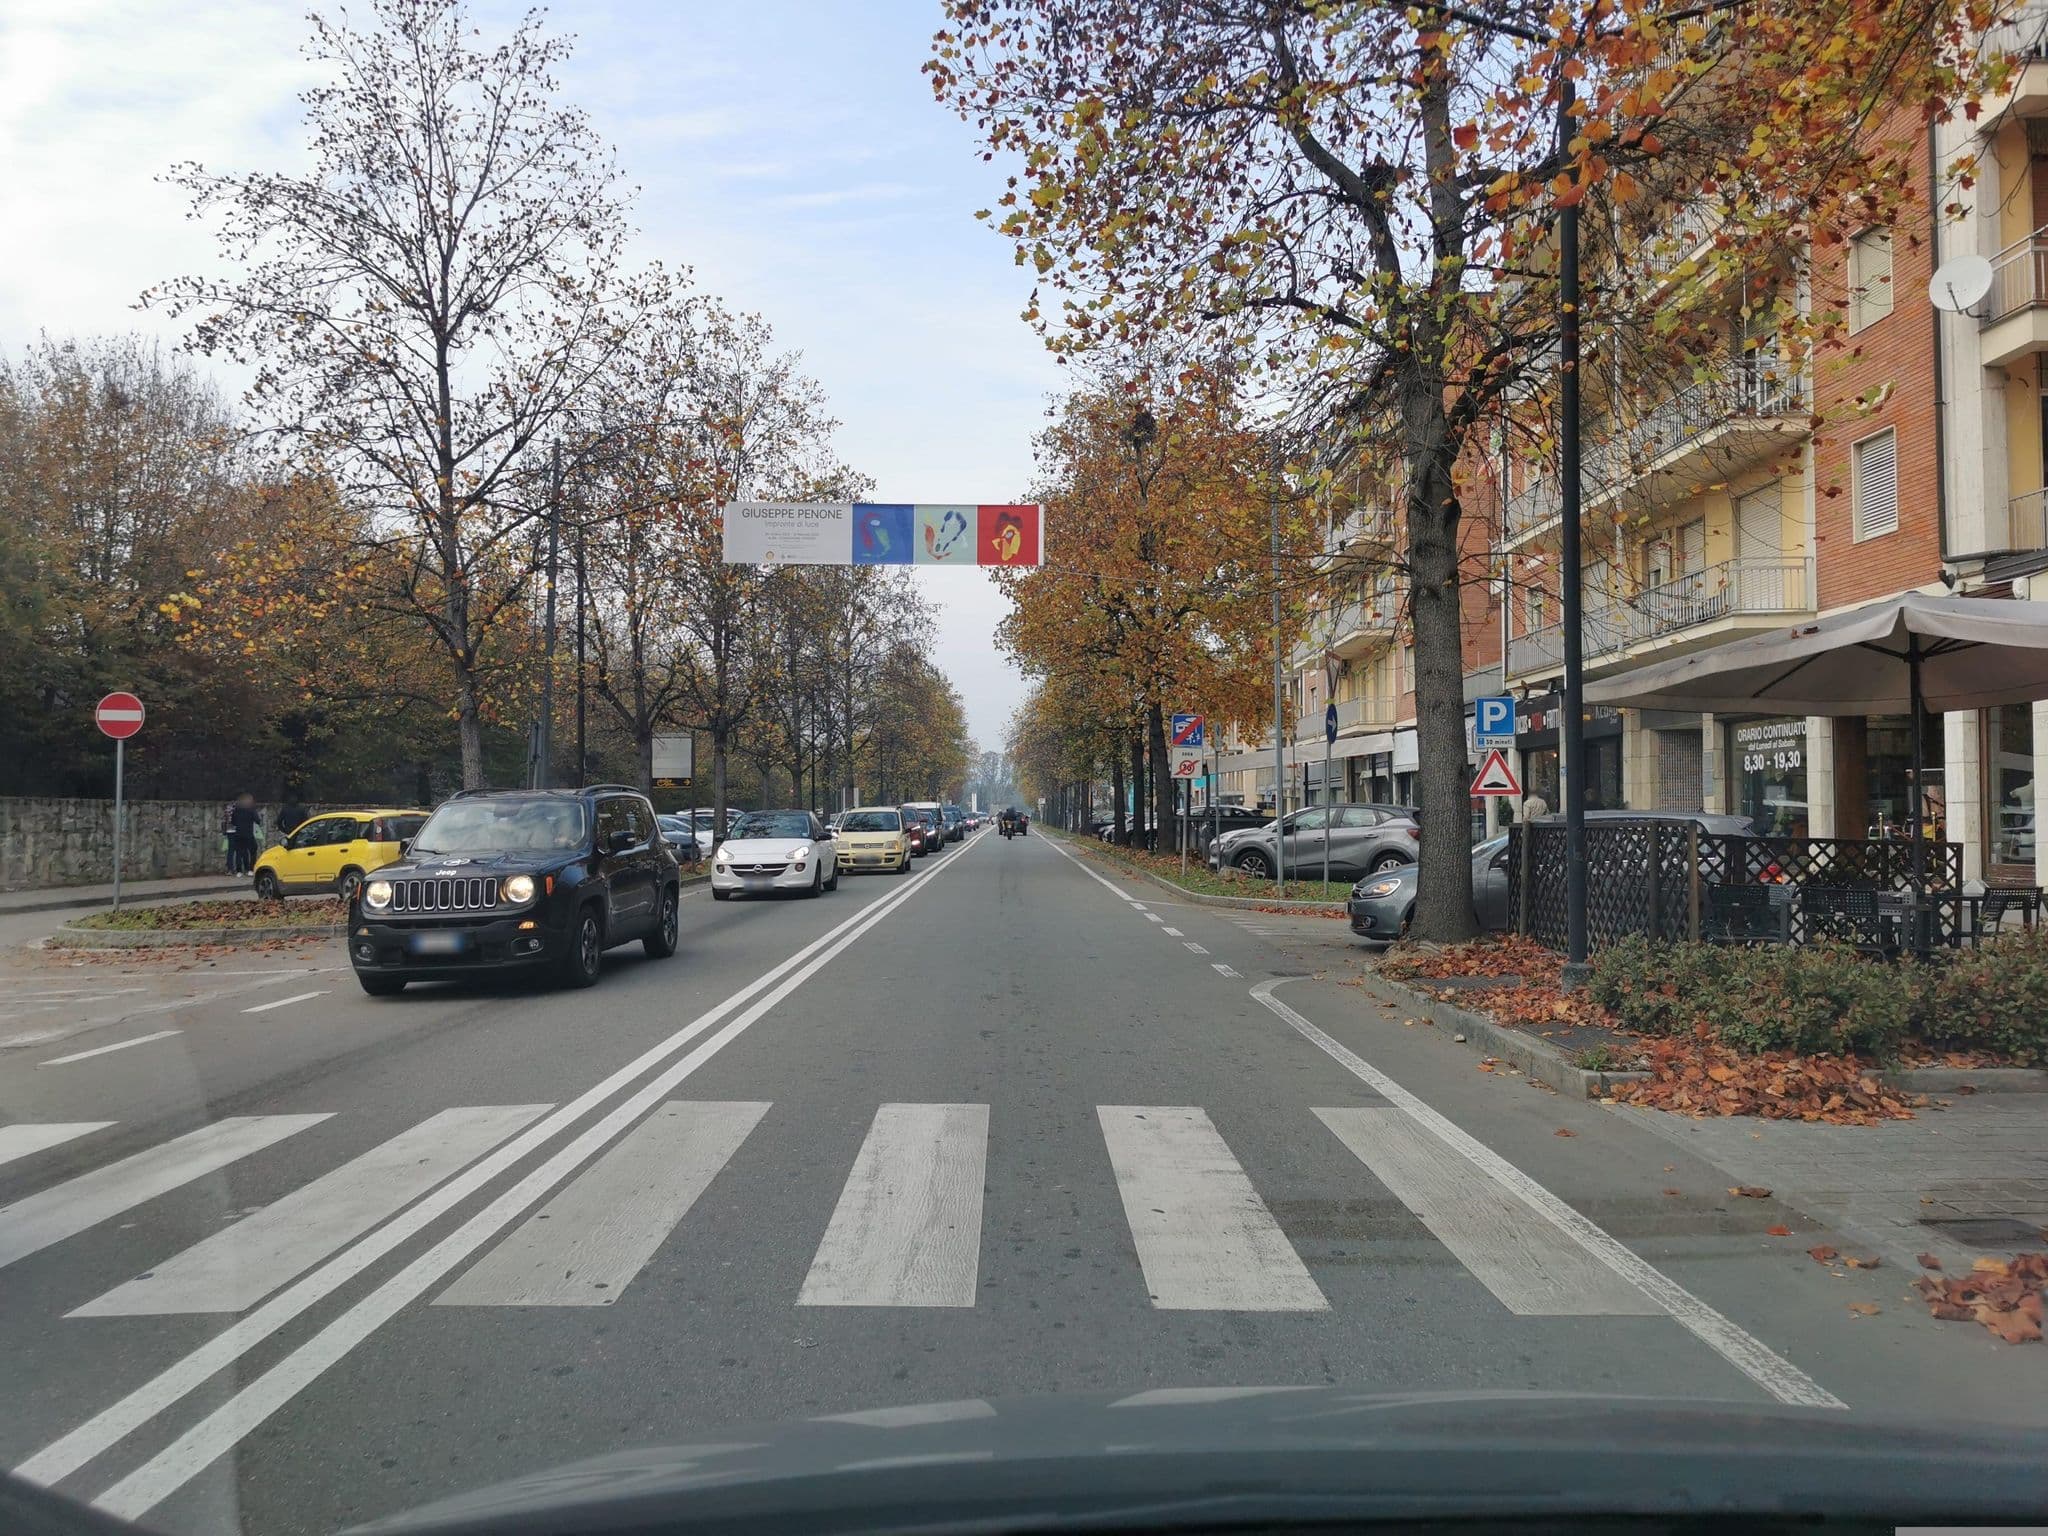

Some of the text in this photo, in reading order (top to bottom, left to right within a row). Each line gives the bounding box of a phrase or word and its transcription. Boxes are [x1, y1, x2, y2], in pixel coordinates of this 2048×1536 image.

[742, 508, 843, 519] GIUSEPPE PENONE
[1483, 701, 1507, 732] P
[1737, 721, 1807, 742] ORARIO CONTINUATO
[1744, 753, 1764, 774] 8,30
[1773, 750, 1801, 772] 19,30
[435, 869, 457, 877] Jeep
